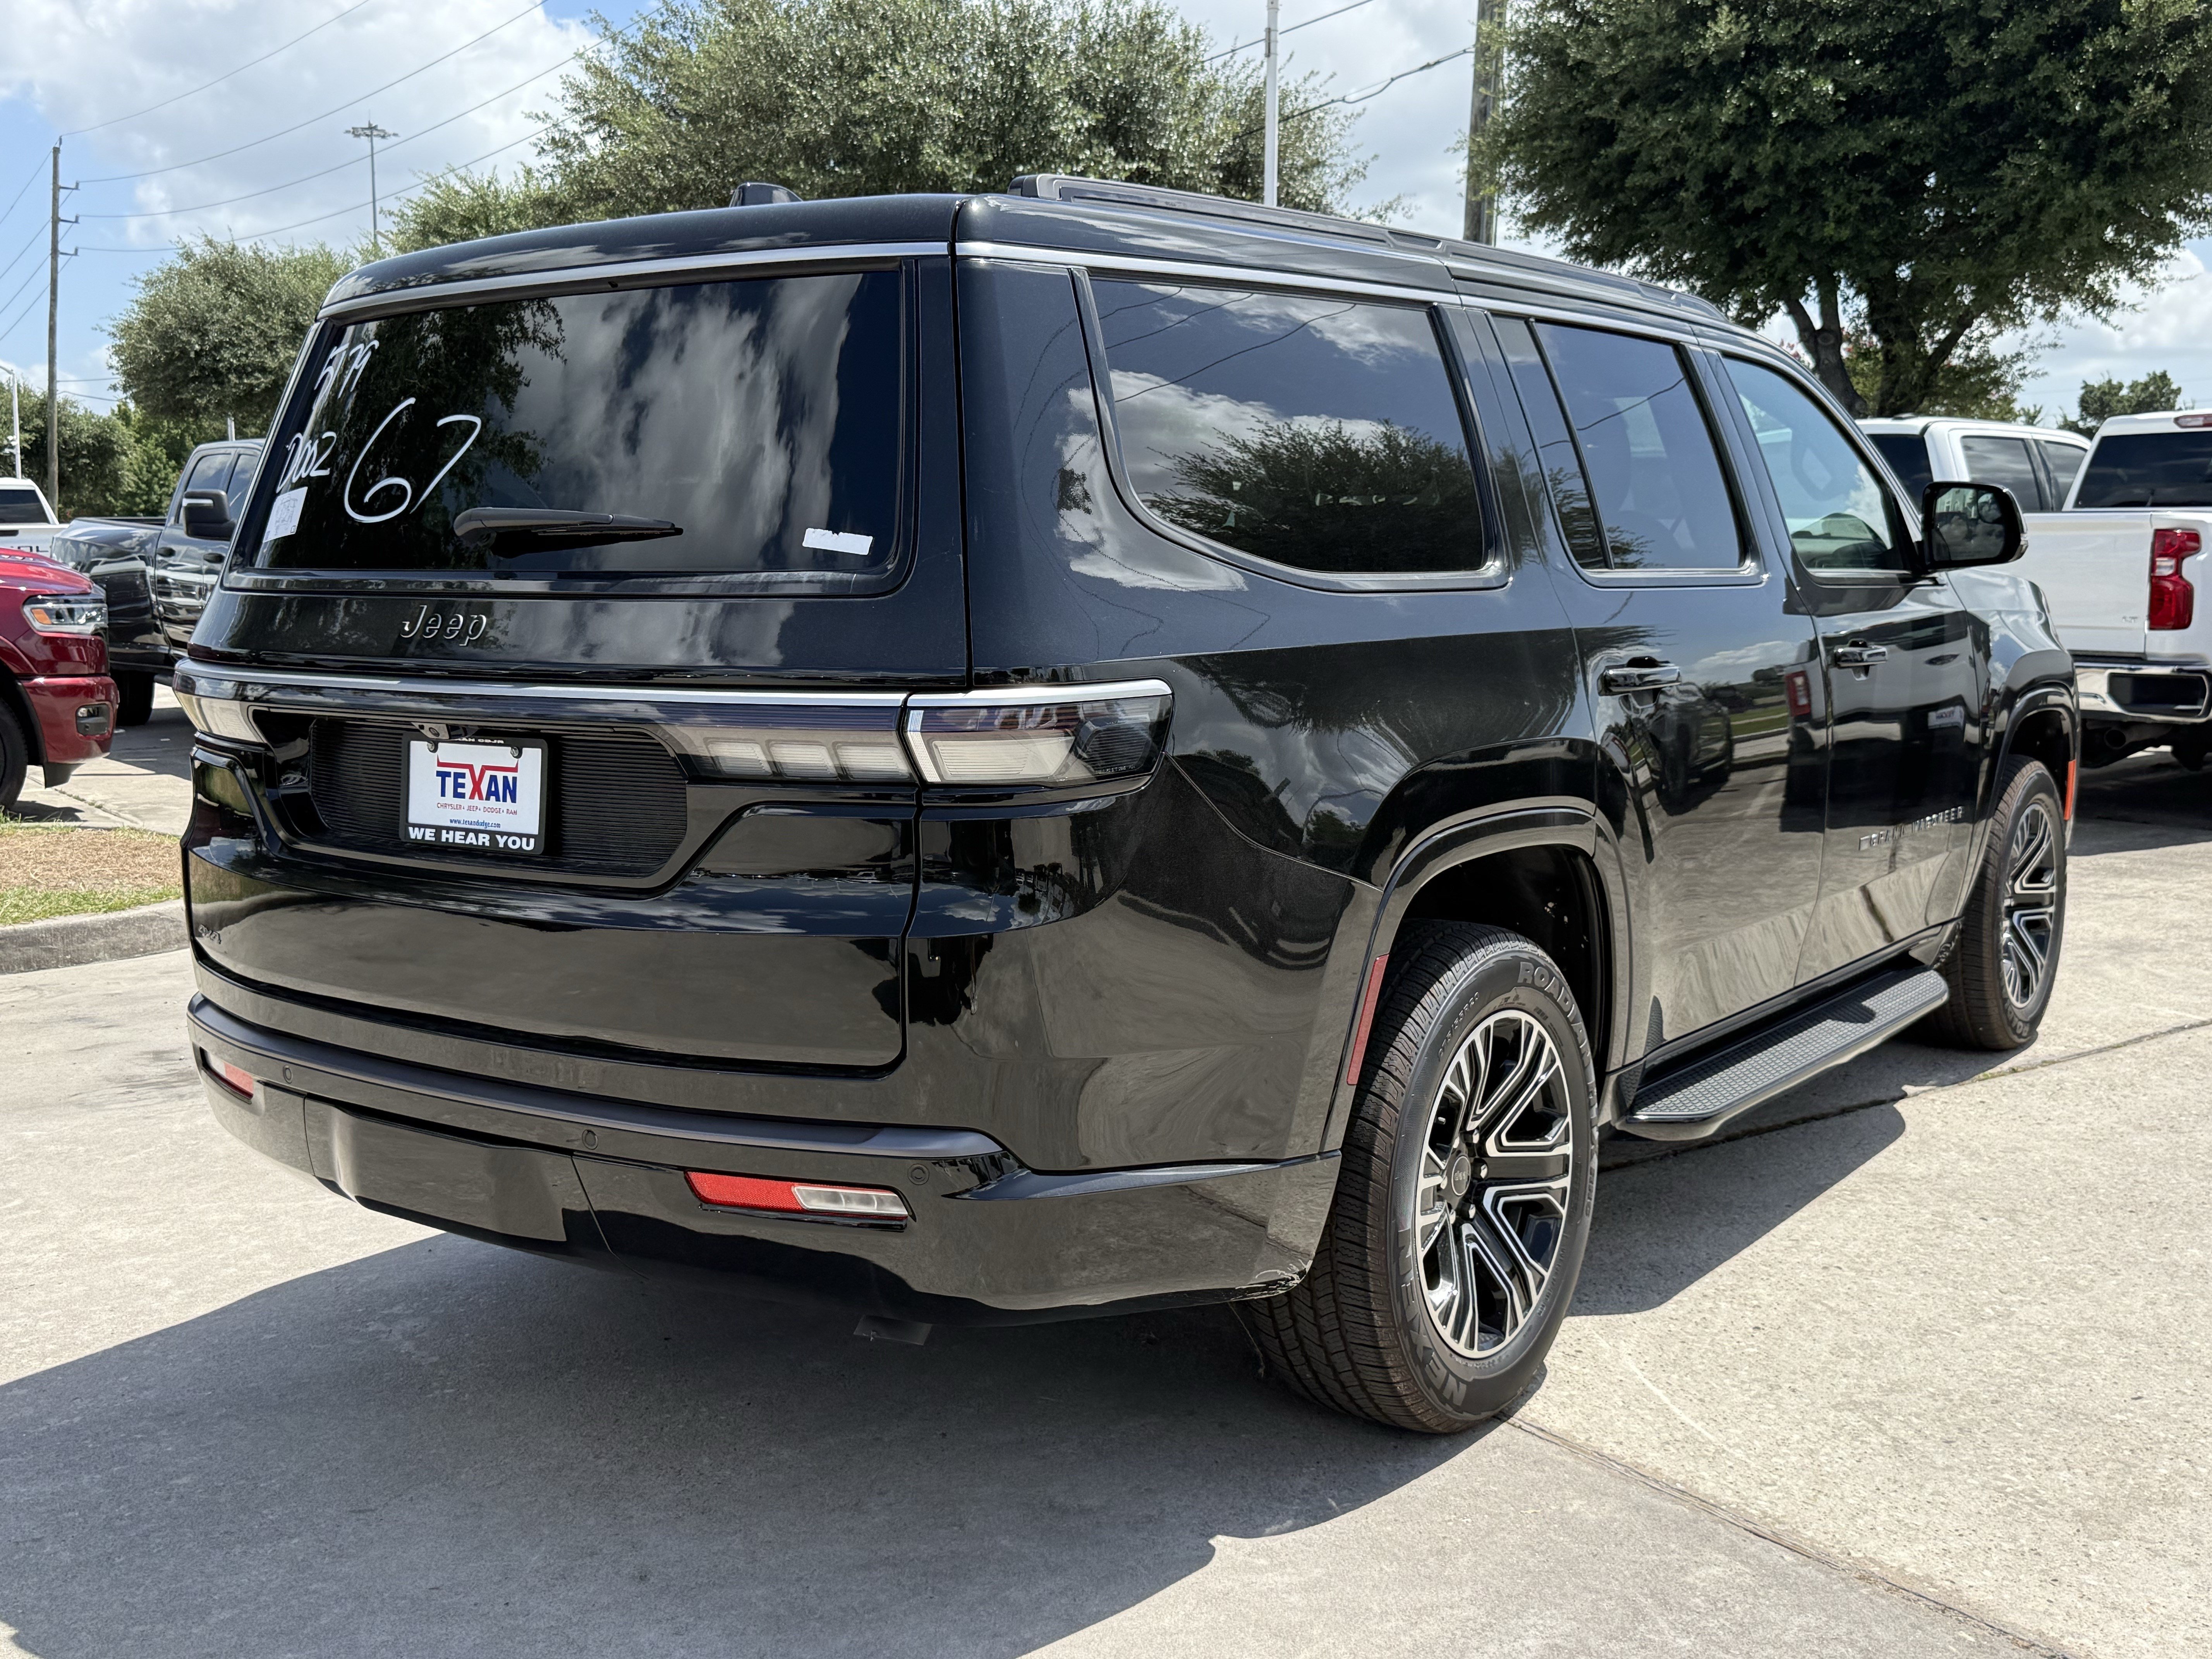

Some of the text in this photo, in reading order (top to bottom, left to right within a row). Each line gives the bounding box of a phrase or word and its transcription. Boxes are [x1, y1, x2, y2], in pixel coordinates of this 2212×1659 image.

[344, 397, 481, 523] 67
[400, 605, 486, 646] Jeep
[436, 755, 519, 804] TEXAN
[408, 826, 535, 851] WE HEAR YOU
[1517, 962, 1591, 1067] ROADIAN
[1398, 1229, 1467, 1406] NEXEN
